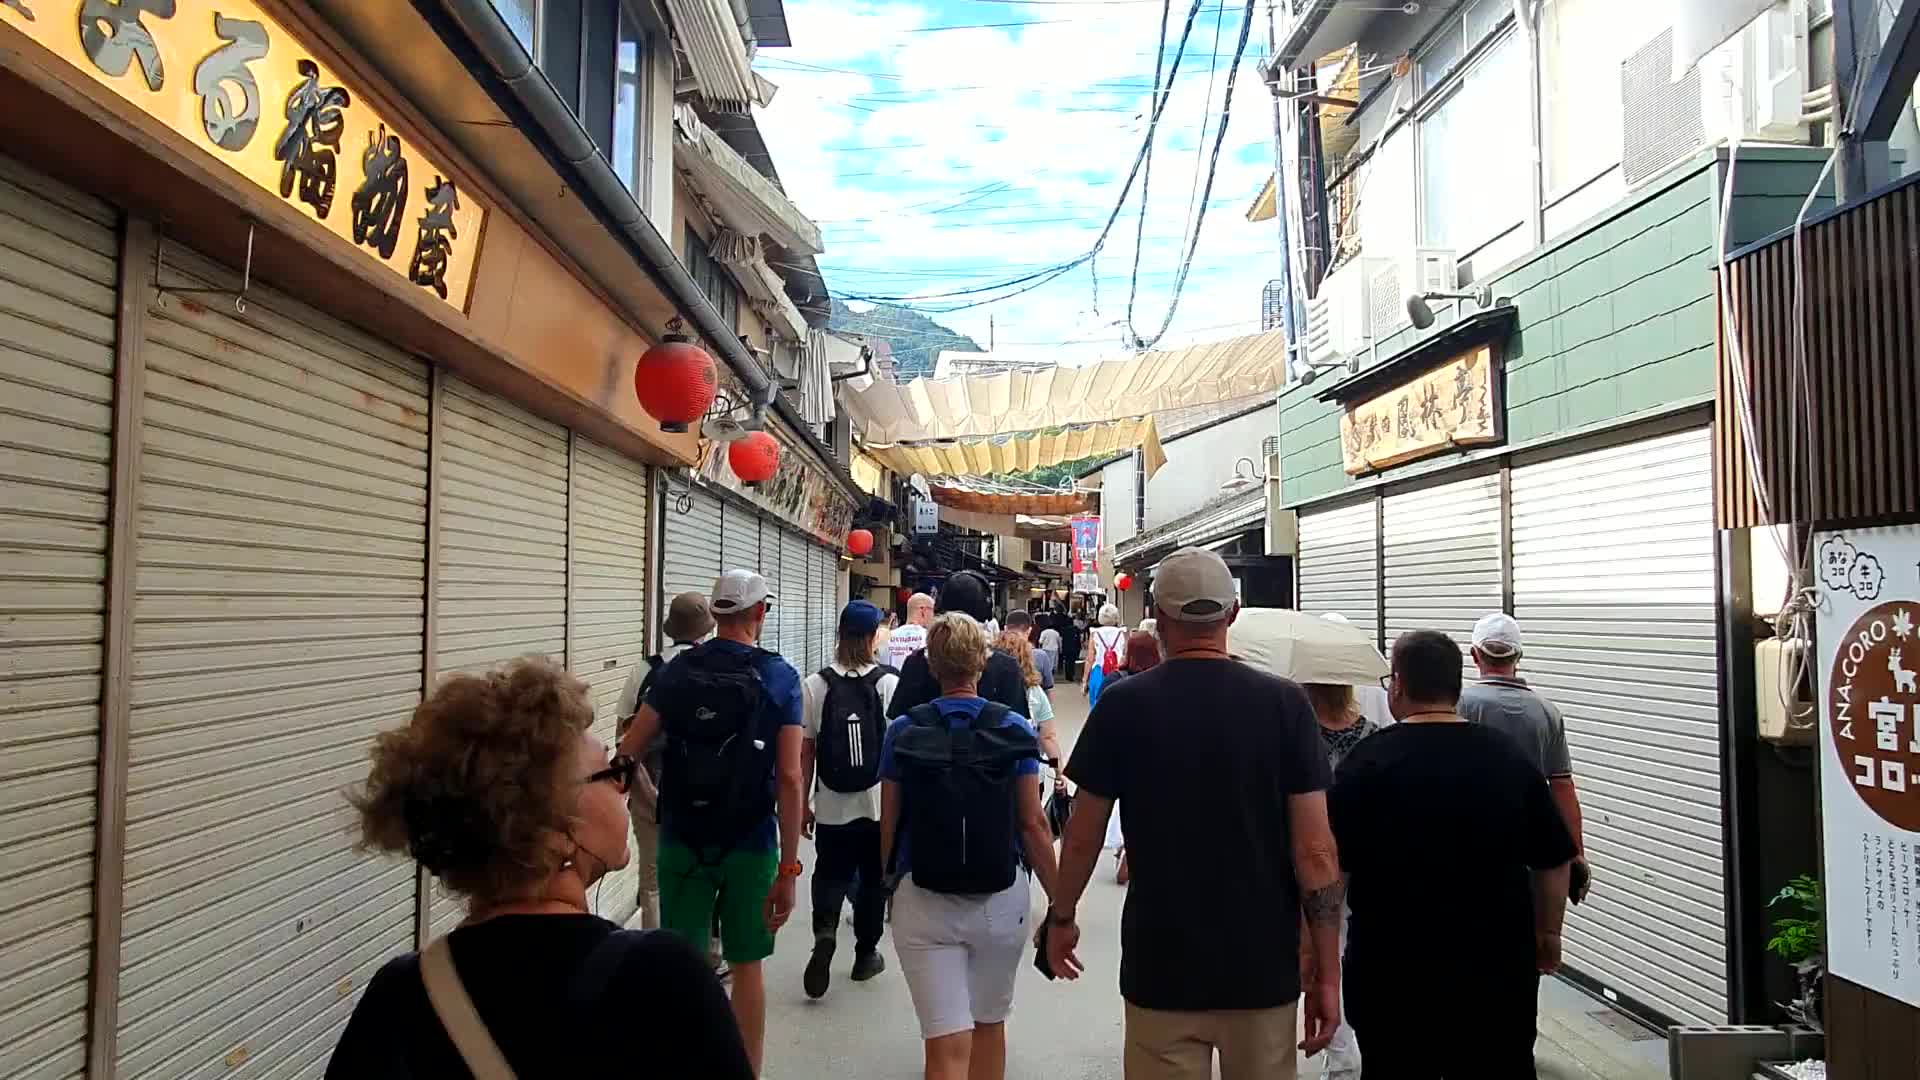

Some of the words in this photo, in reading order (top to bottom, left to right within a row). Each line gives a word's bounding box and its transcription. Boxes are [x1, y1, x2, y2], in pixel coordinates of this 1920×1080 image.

[1832, 568, 1845, 577] コロ
[1859, 582, 1873, 591] コロ
[1836, 620, 1887, 740] ANA-CORO
